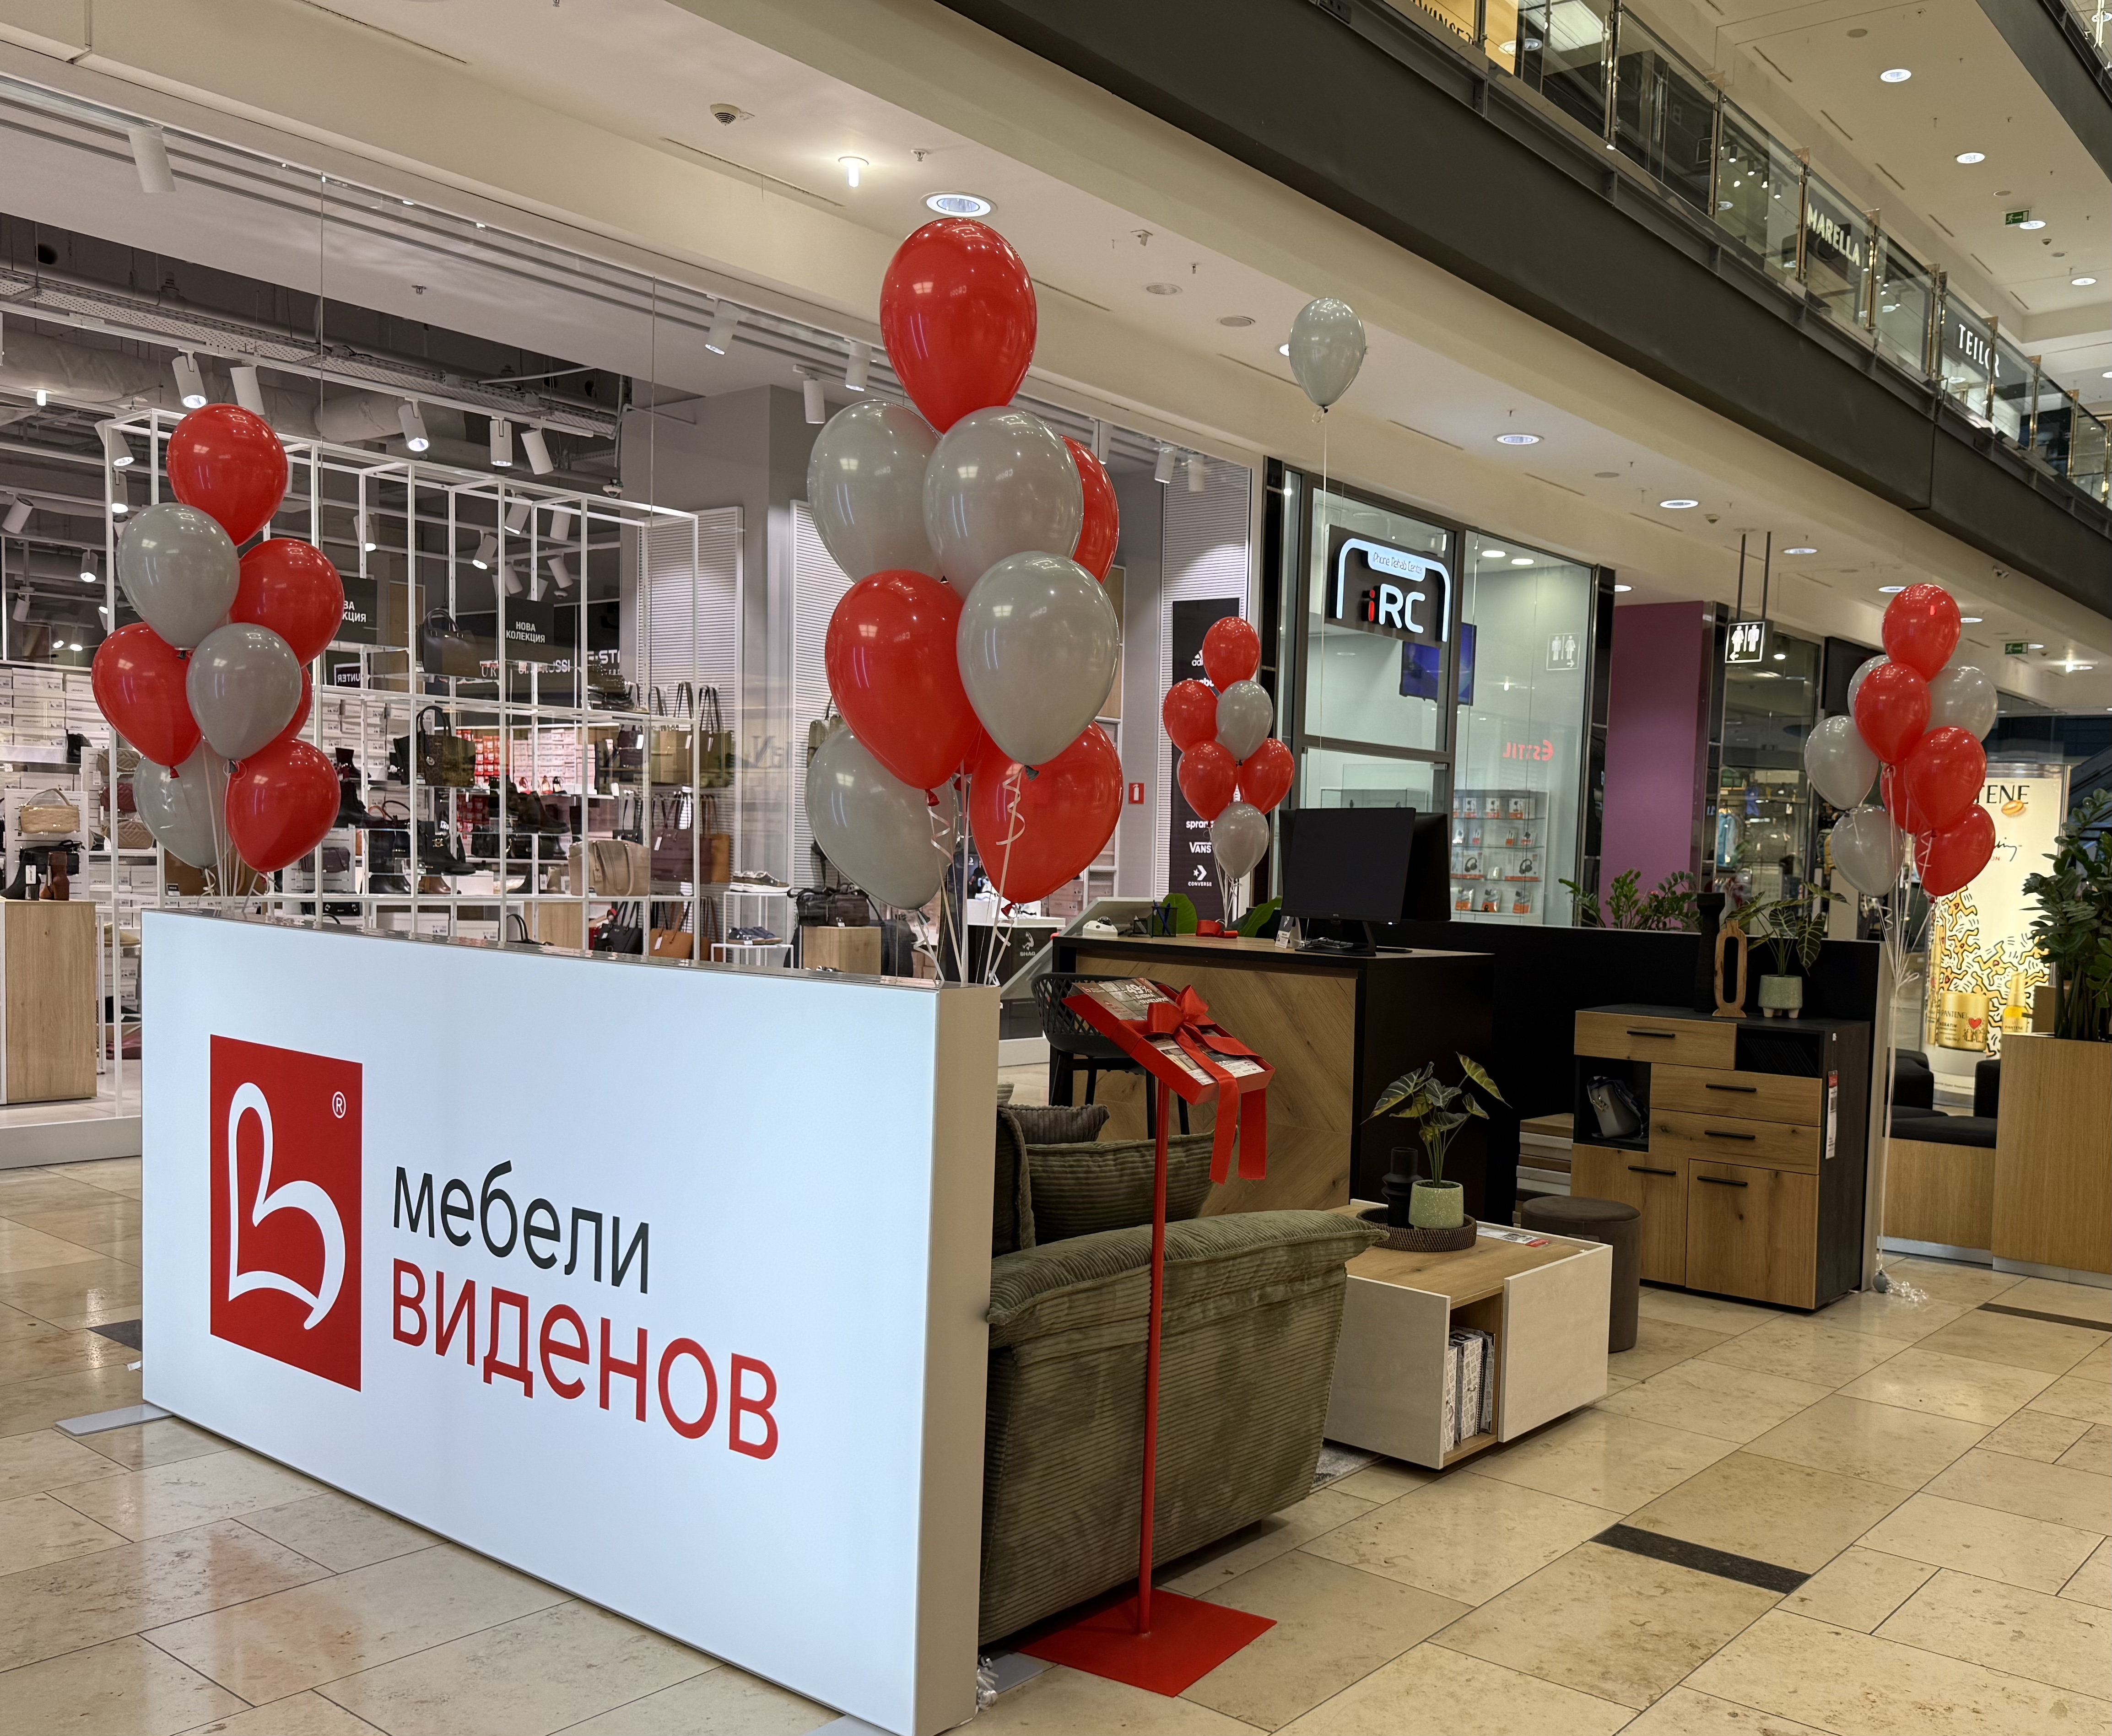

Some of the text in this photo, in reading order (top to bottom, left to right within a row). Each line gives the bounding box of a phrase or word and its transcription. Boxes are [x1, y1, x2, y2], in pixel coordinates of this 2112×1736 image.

[1807, 203, 1860, 267] MARELLA
[343, 600, 355, 610] ВА
[1368, 583, 1426, 634] iRC
[342, 611, 367, 623] КЦИЯ
[516, 621, 536, 632] НОВА
[506, 630, 546, 643] КОЛЕКЦИЯ
[1189, 841, 1212, 853] VANS
[1941, 1009, 1966, 1019] PANTENE
[393, 1160, 649, 1294] мебели
